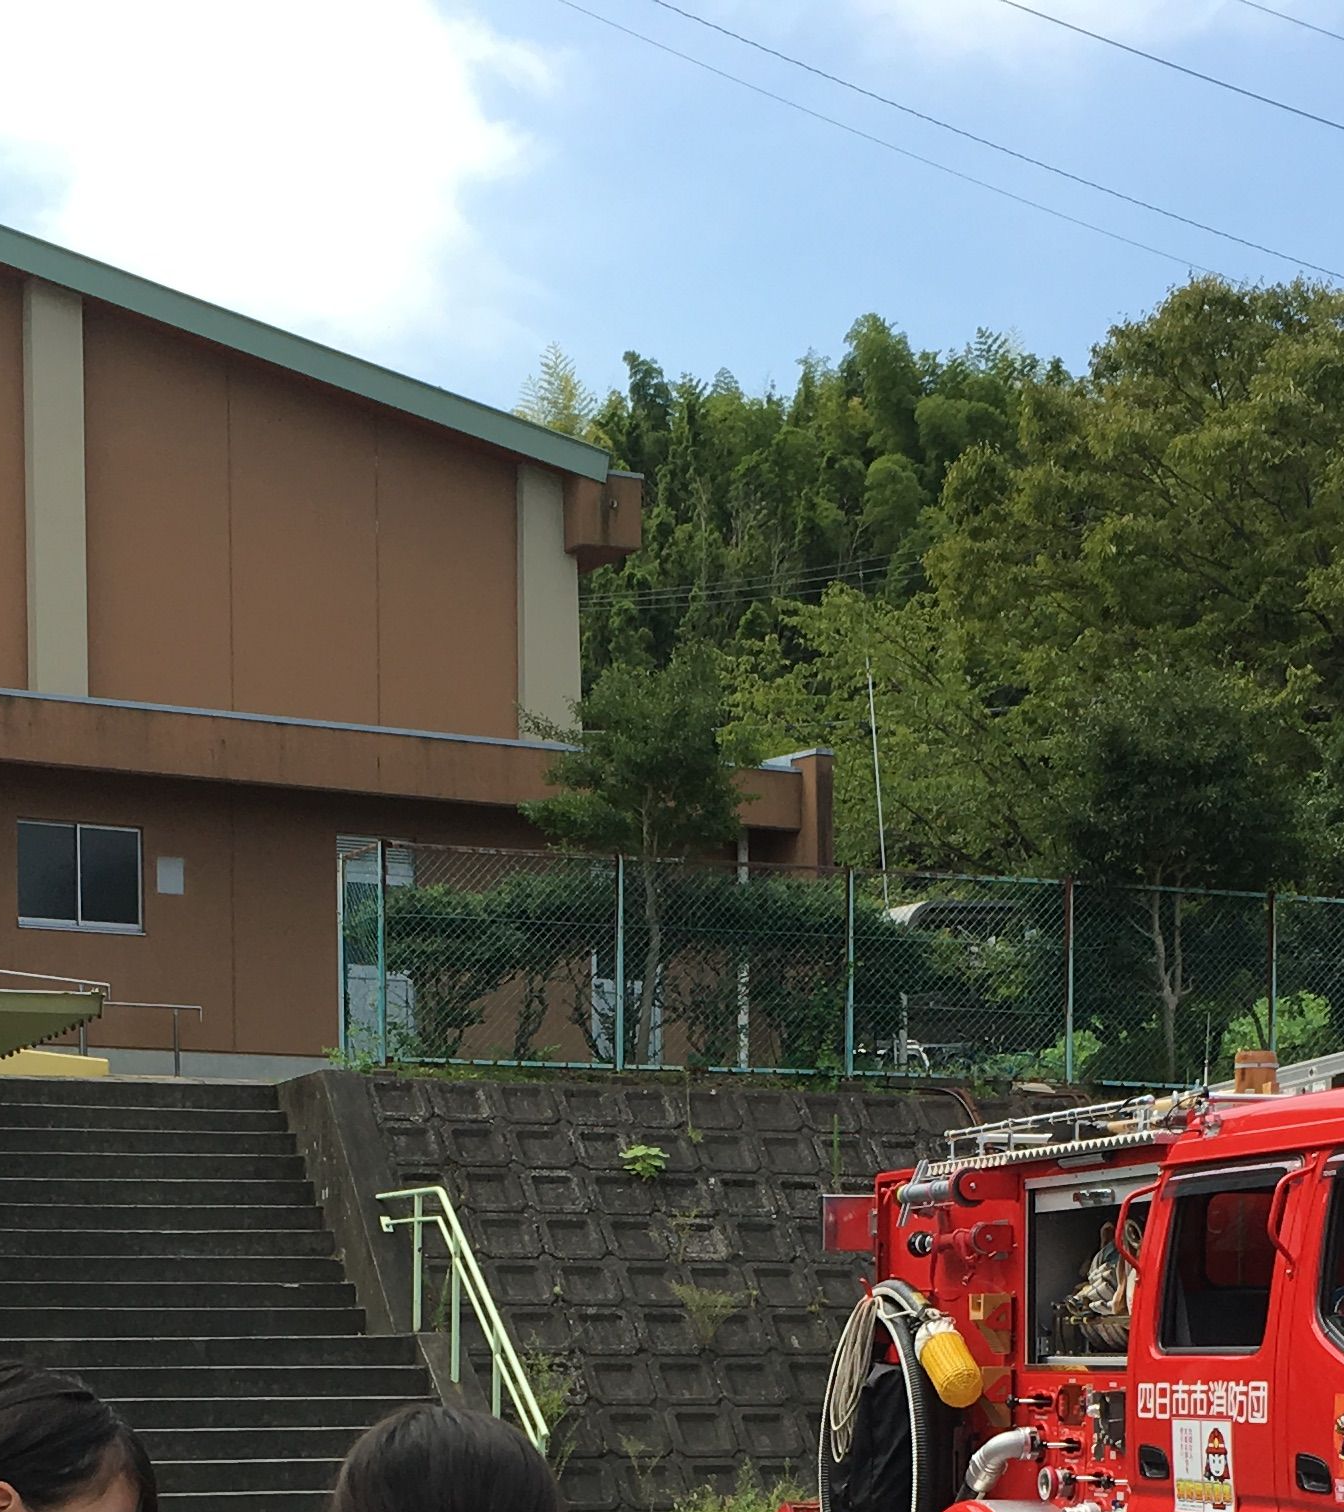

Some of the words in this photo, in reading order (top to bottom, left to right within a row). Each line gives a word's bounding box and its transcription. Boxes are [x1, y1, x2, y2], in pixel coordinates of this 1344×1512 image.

[1137, 1380, 1269, 1424] 四日市市消防団
